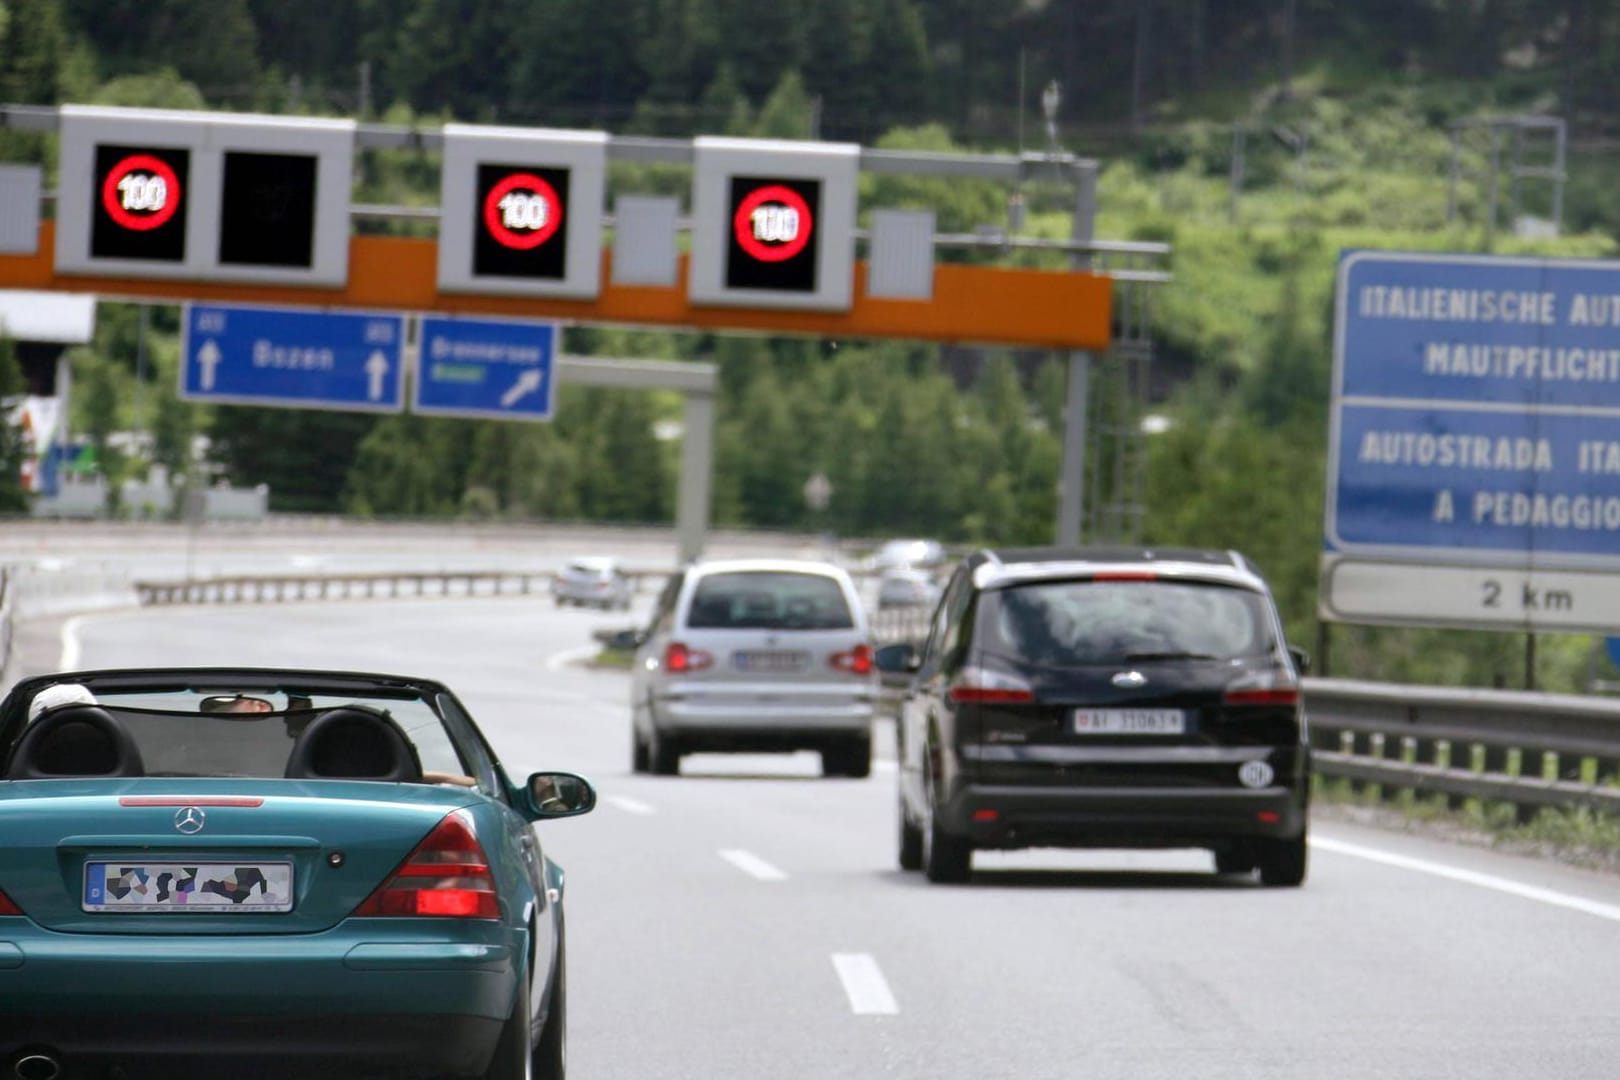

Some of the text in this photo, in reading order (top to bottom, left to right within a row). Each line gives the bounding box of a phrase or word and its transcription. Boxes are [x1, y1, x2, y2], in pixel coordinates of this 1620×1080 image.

[118, 174, 166, 211] 100
[498, 192, 548, 230] 100
[751, 205, 799, 242] 100
[1360, 285, 1556, 325] ITALIENISCHE
[253, 338, 334, 369] Bozen
[1424, 341, 1620, 381] MAUTPFLICHT
[1359, 430, 1552, 472] AUTOSTRADA
[1433, 488, 1620, 530] A PEDAGGIO
[1482, 579, 1573, 611] 2 km
